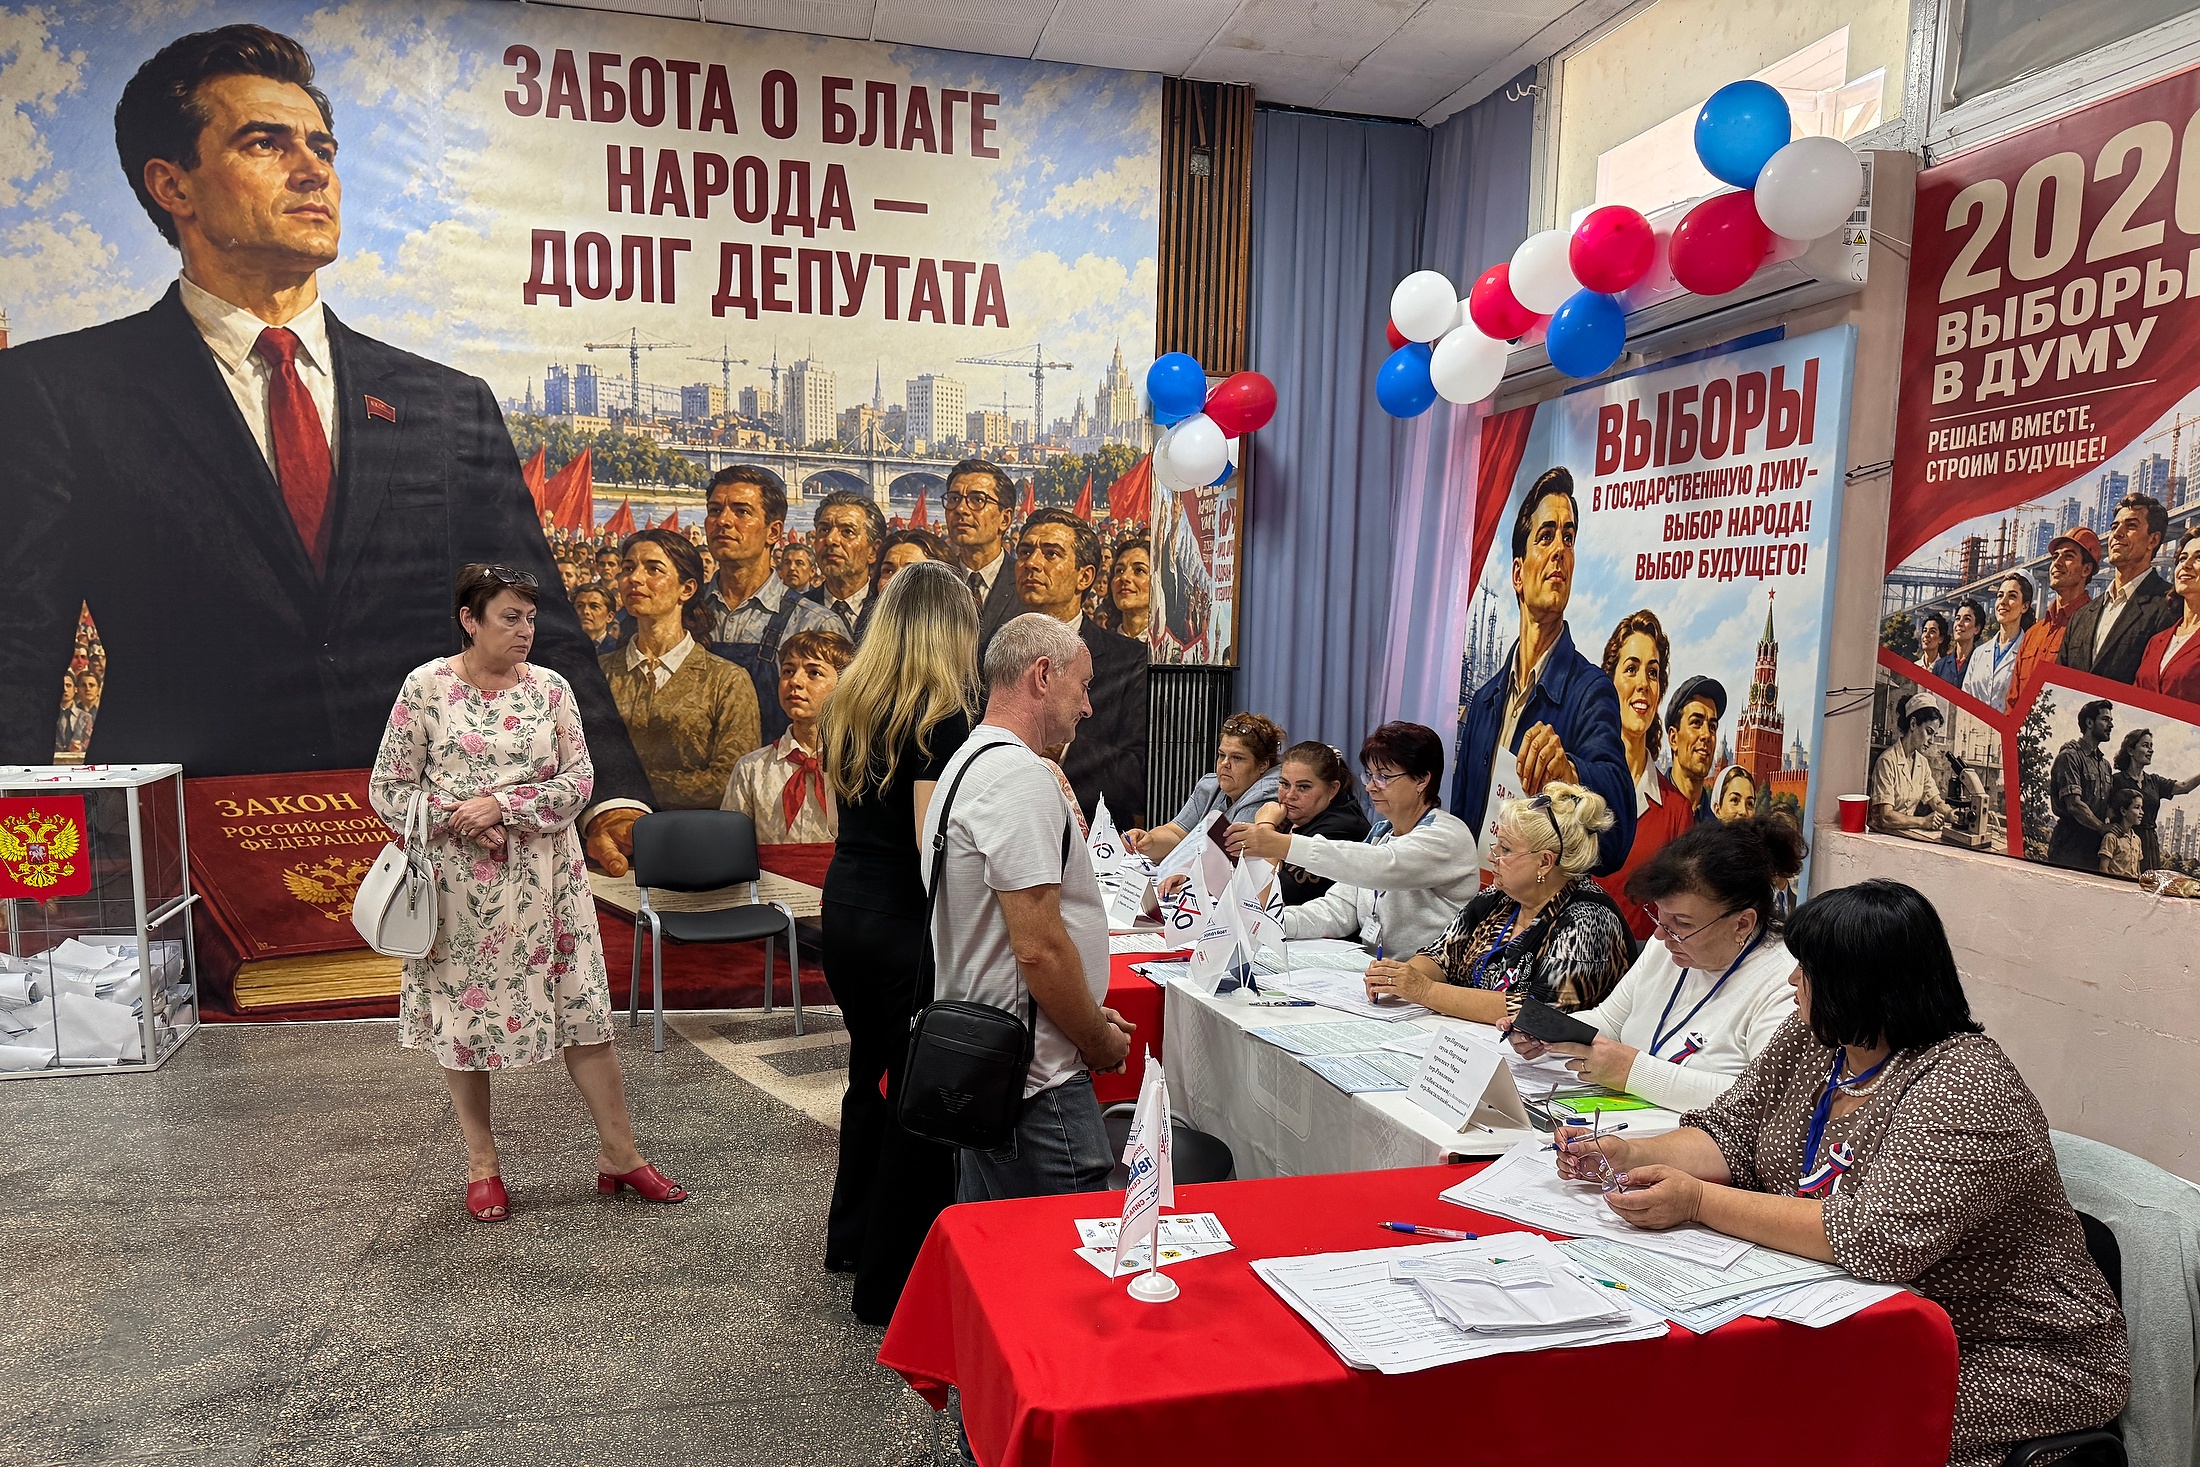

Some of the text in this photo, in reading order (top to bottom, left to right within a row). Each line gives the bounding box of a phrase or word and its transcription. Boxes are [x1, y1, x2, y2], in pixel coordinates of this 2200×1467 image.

[503, 44, 1001, 159] ЗАБОТА О БЛАГЕ
[606, 144, 857, 239] НАРОДА
[522, 228, 1010, 328] ДОЛГ ДЕПУТАТА
[1931, 315, 2159, 405] В ДУМУ
[1594, 357, 1821, 477] ВЫБОРЫ
[1927, 404, 2096, 454] РЕШАЕМ ВМЕСТЕ,
[1925, 435, 2108, 484] СТРОИМ БУДУЩЕЕ!
[1592, 486, 1602, 512] В
[1662, 500, 1813, 542] ВЫБОР НАРОДА!
[1634, 542, 1809, 583] ВЫБОР БУДУЩЕГО!
[214, 792, 362, 818] ЗАКОН
[221, 815, 385, 839] РОССИЙСКОЙ
[239, 830, 393, 851] ФЕДЕРАЦИИ
